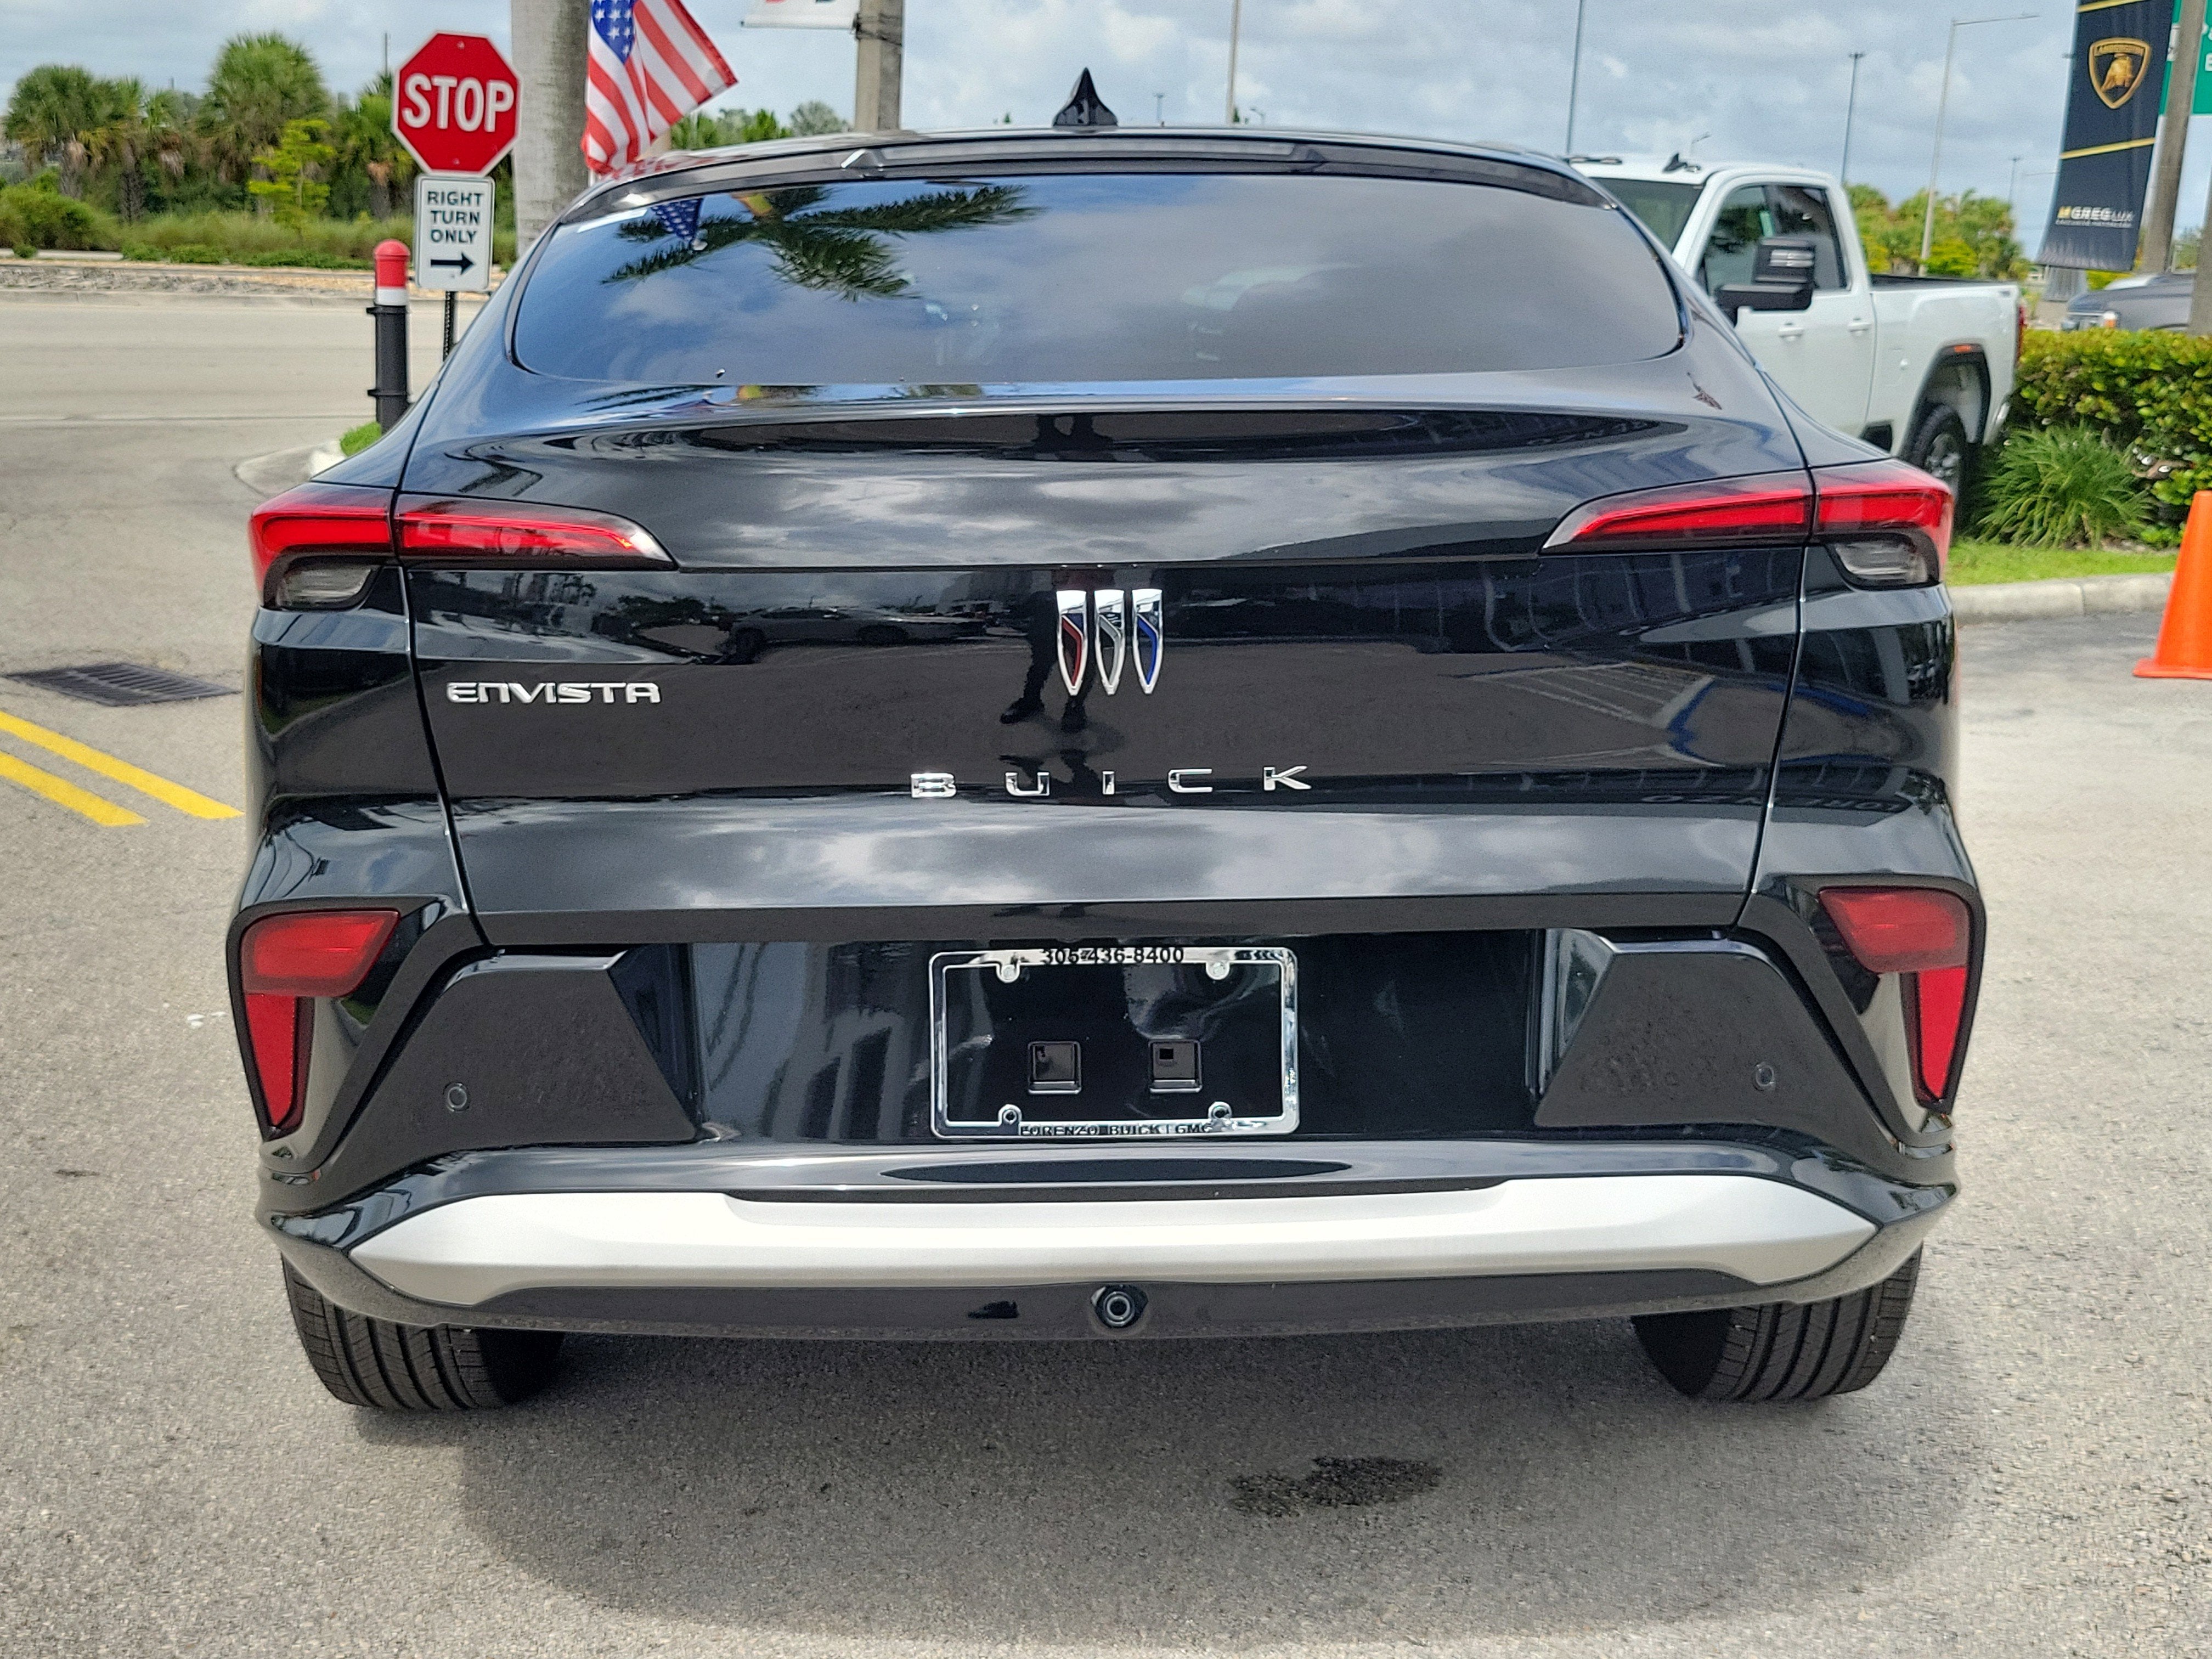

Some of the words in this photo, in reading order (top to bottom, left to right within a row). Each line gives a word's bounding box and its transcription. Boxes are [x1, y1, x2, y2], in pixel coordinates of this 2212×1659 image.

[401, 72, 515, 133] STOP
[428, 191, 483, 206] RIGHT
[430, 210, 480, 225] TURN
[431, 229, 477, 243] ONLY
[447, 682, 661, 704] ENVISTA
[910, 765, 1312, 798] BUICK
[1040, 947, 1184, 964] 305-436-8400
[1108, 1124, 1160, 1135] BUICK
[1175, 1124, 1212, 1134] GMC
